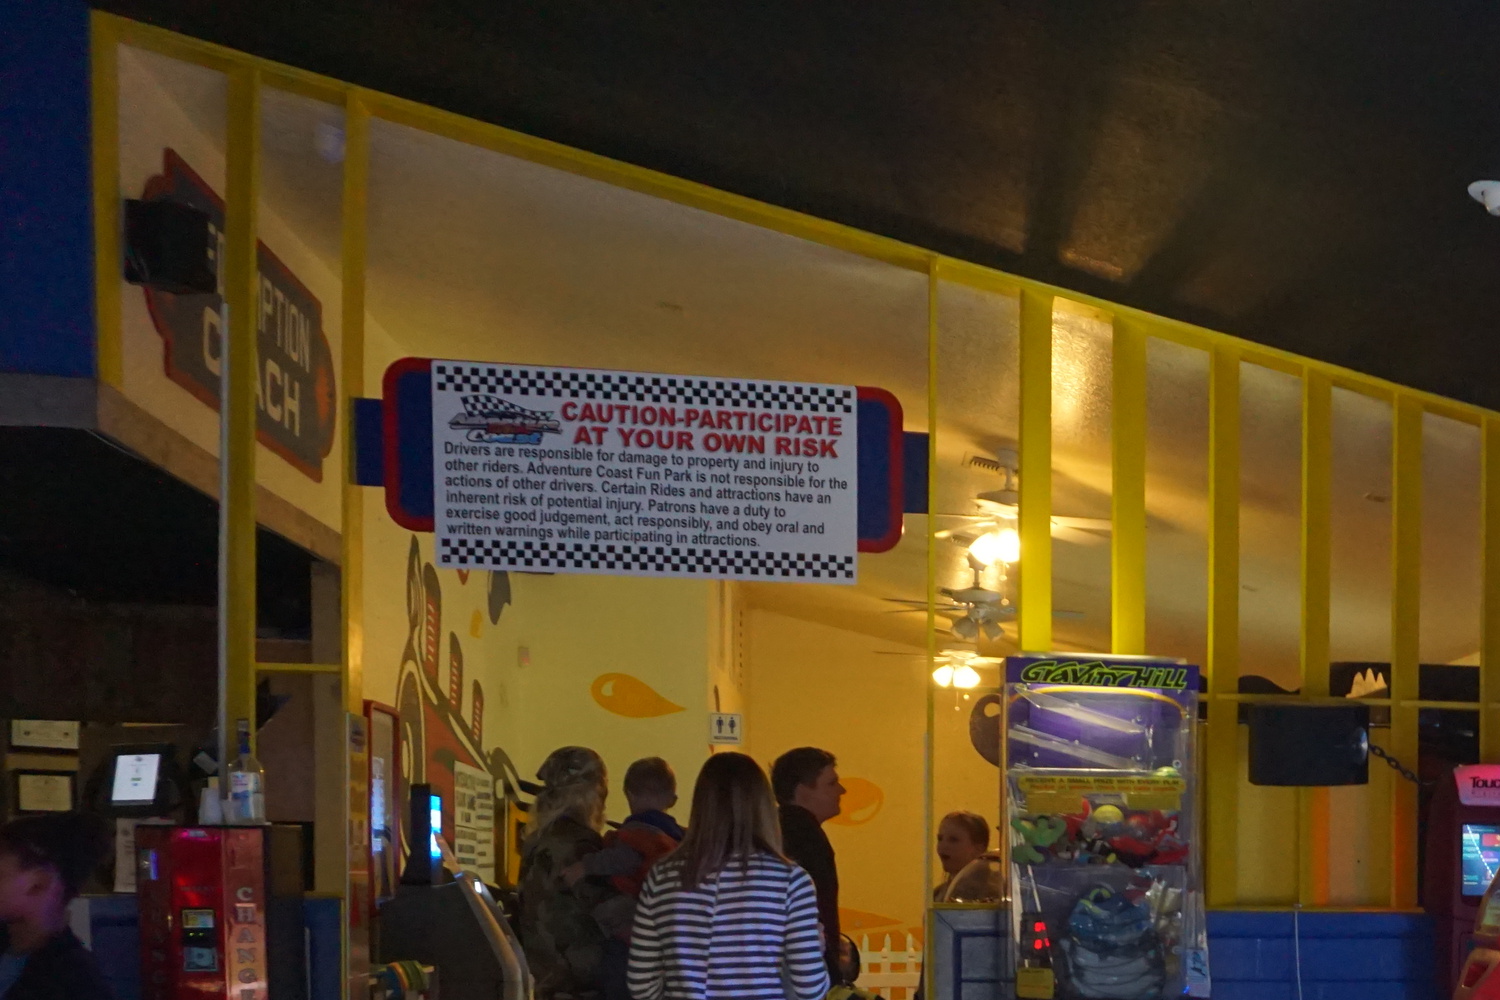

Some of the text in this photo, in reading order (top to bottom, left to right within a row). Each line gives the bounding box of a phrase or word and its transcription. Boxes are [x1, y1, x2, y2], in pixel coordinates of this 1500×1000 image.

[203, 305, 301, 438] CCH
[561, 401, 843, 436] CAUTION-PARTICIPATE
[573, 425, 609, 446] AT
[617, 426, 695, 451] YOUR
[703, 432, 766, 454] OWN
[775, 436, 839, 459] RISK
[444, 441, 820, 475] Drivers are responsible for damage to property and injury to
[445, 459, 848, 490] other riders. Adventure Coast Fun Park is not responsible for the
[445, 475, 831, 504] actions of other drivers. Certain Rides and attractions have an
[446, 490, 786, 520] inherent risk of potential injury. Patrons have a duty to
[446, 507, 825, 535] exercise good judgement, act responsibly, and obey oral and
[447, 522, 760, 548] written warnings while participating in attractions.
